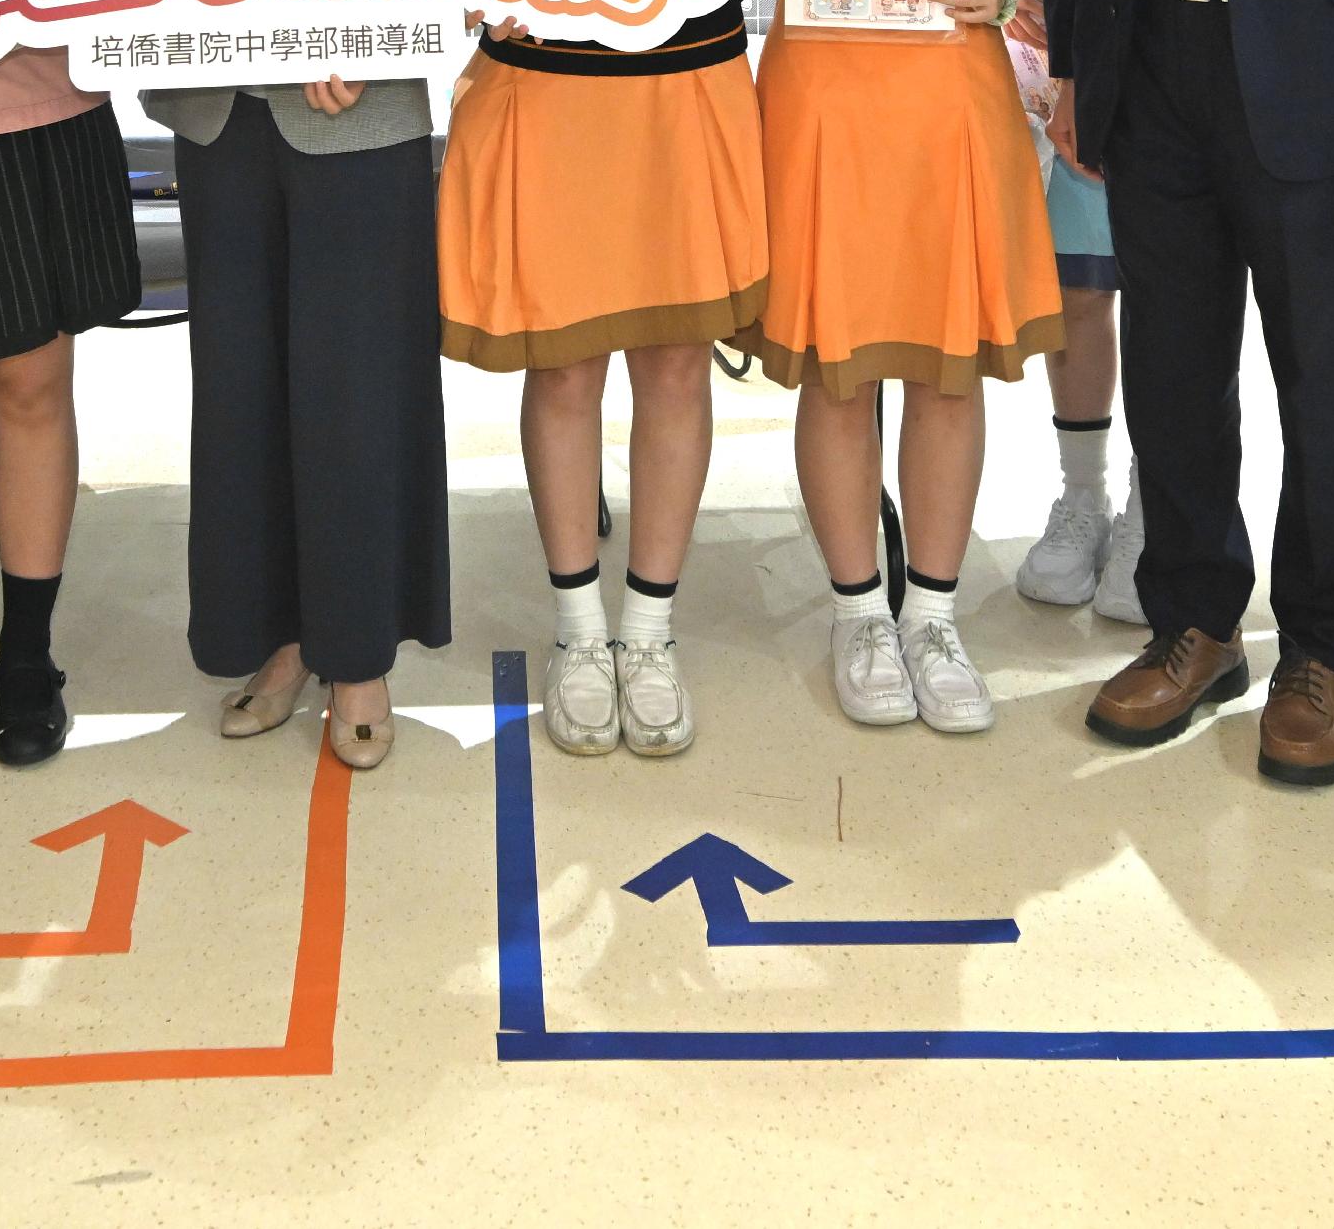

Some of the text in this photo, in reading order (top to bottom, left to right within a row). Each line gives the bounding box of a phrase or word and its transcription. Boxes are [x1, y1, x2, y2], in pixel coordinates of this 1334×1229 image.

[89, 23, 445, 70] 培僑書院中學部輔導組
